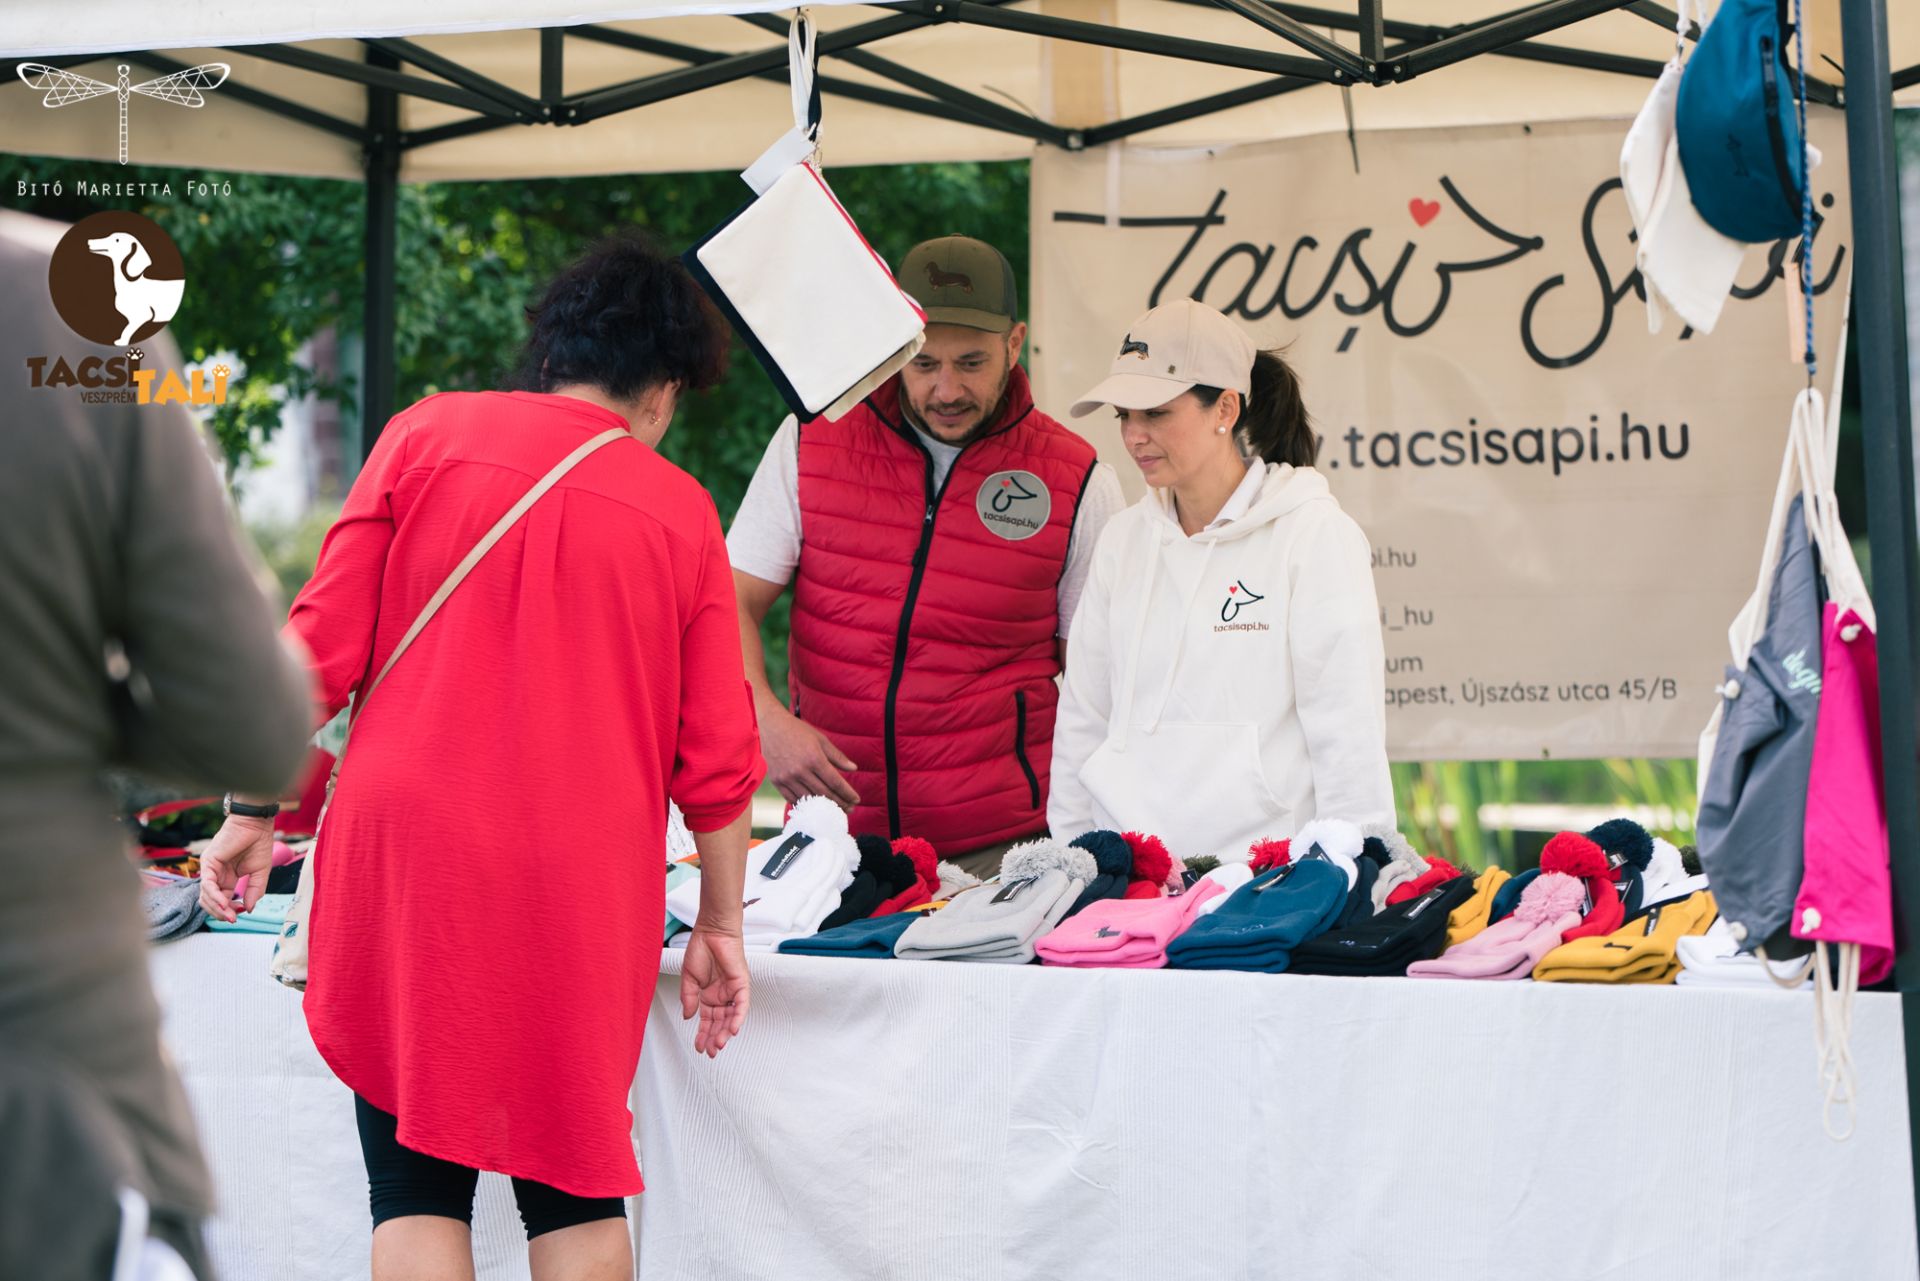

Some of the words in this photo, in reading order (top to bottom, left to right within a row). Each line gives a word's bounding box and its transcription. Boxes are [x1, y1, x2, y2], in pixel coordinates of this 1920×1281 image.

[1313, 411, 1690, 477] .tacsisapi.hu
[983, 511, 1040, 530] tacsisapi.hu
[1213, 622, 1269, 632] tacsisapi.hu
[1380, 605, 1433, 631] i_hu
[1384, 684, 1455, 709] apest,
[1461, 677, 1550, 708] Újszász
[1557, 681, 1610, 701] utca
[1618, 675, 1678, 702] 45/B
